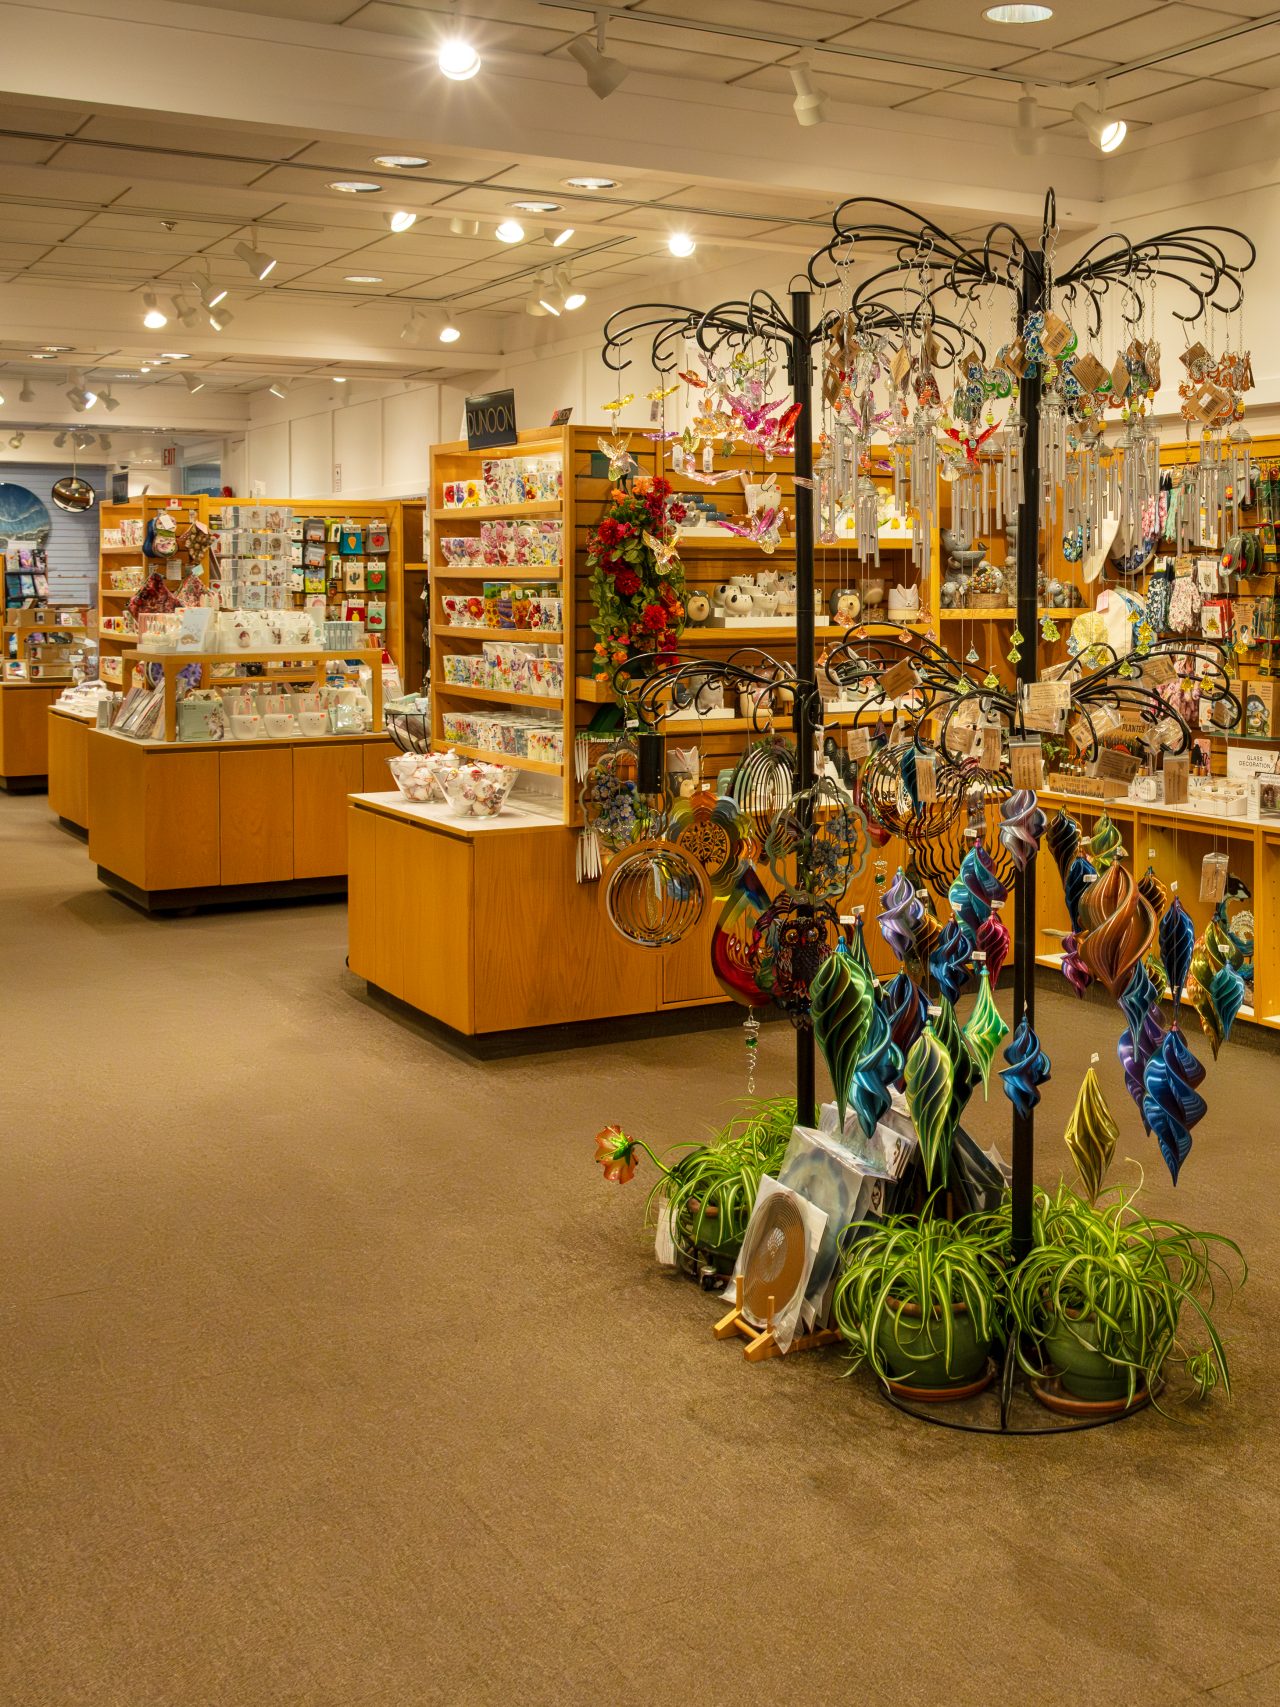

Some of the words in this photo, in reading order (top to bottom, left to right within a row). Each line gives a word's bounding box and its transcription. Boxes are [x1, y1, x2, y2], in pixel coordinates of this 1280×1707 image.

[467, 404, 514, 436] DUNOON
[164, 448, 175, 465] EXIT
[1122, 724, 1145, 733] PLANTES
[1239, 761, 1271, 769] DECORATION
